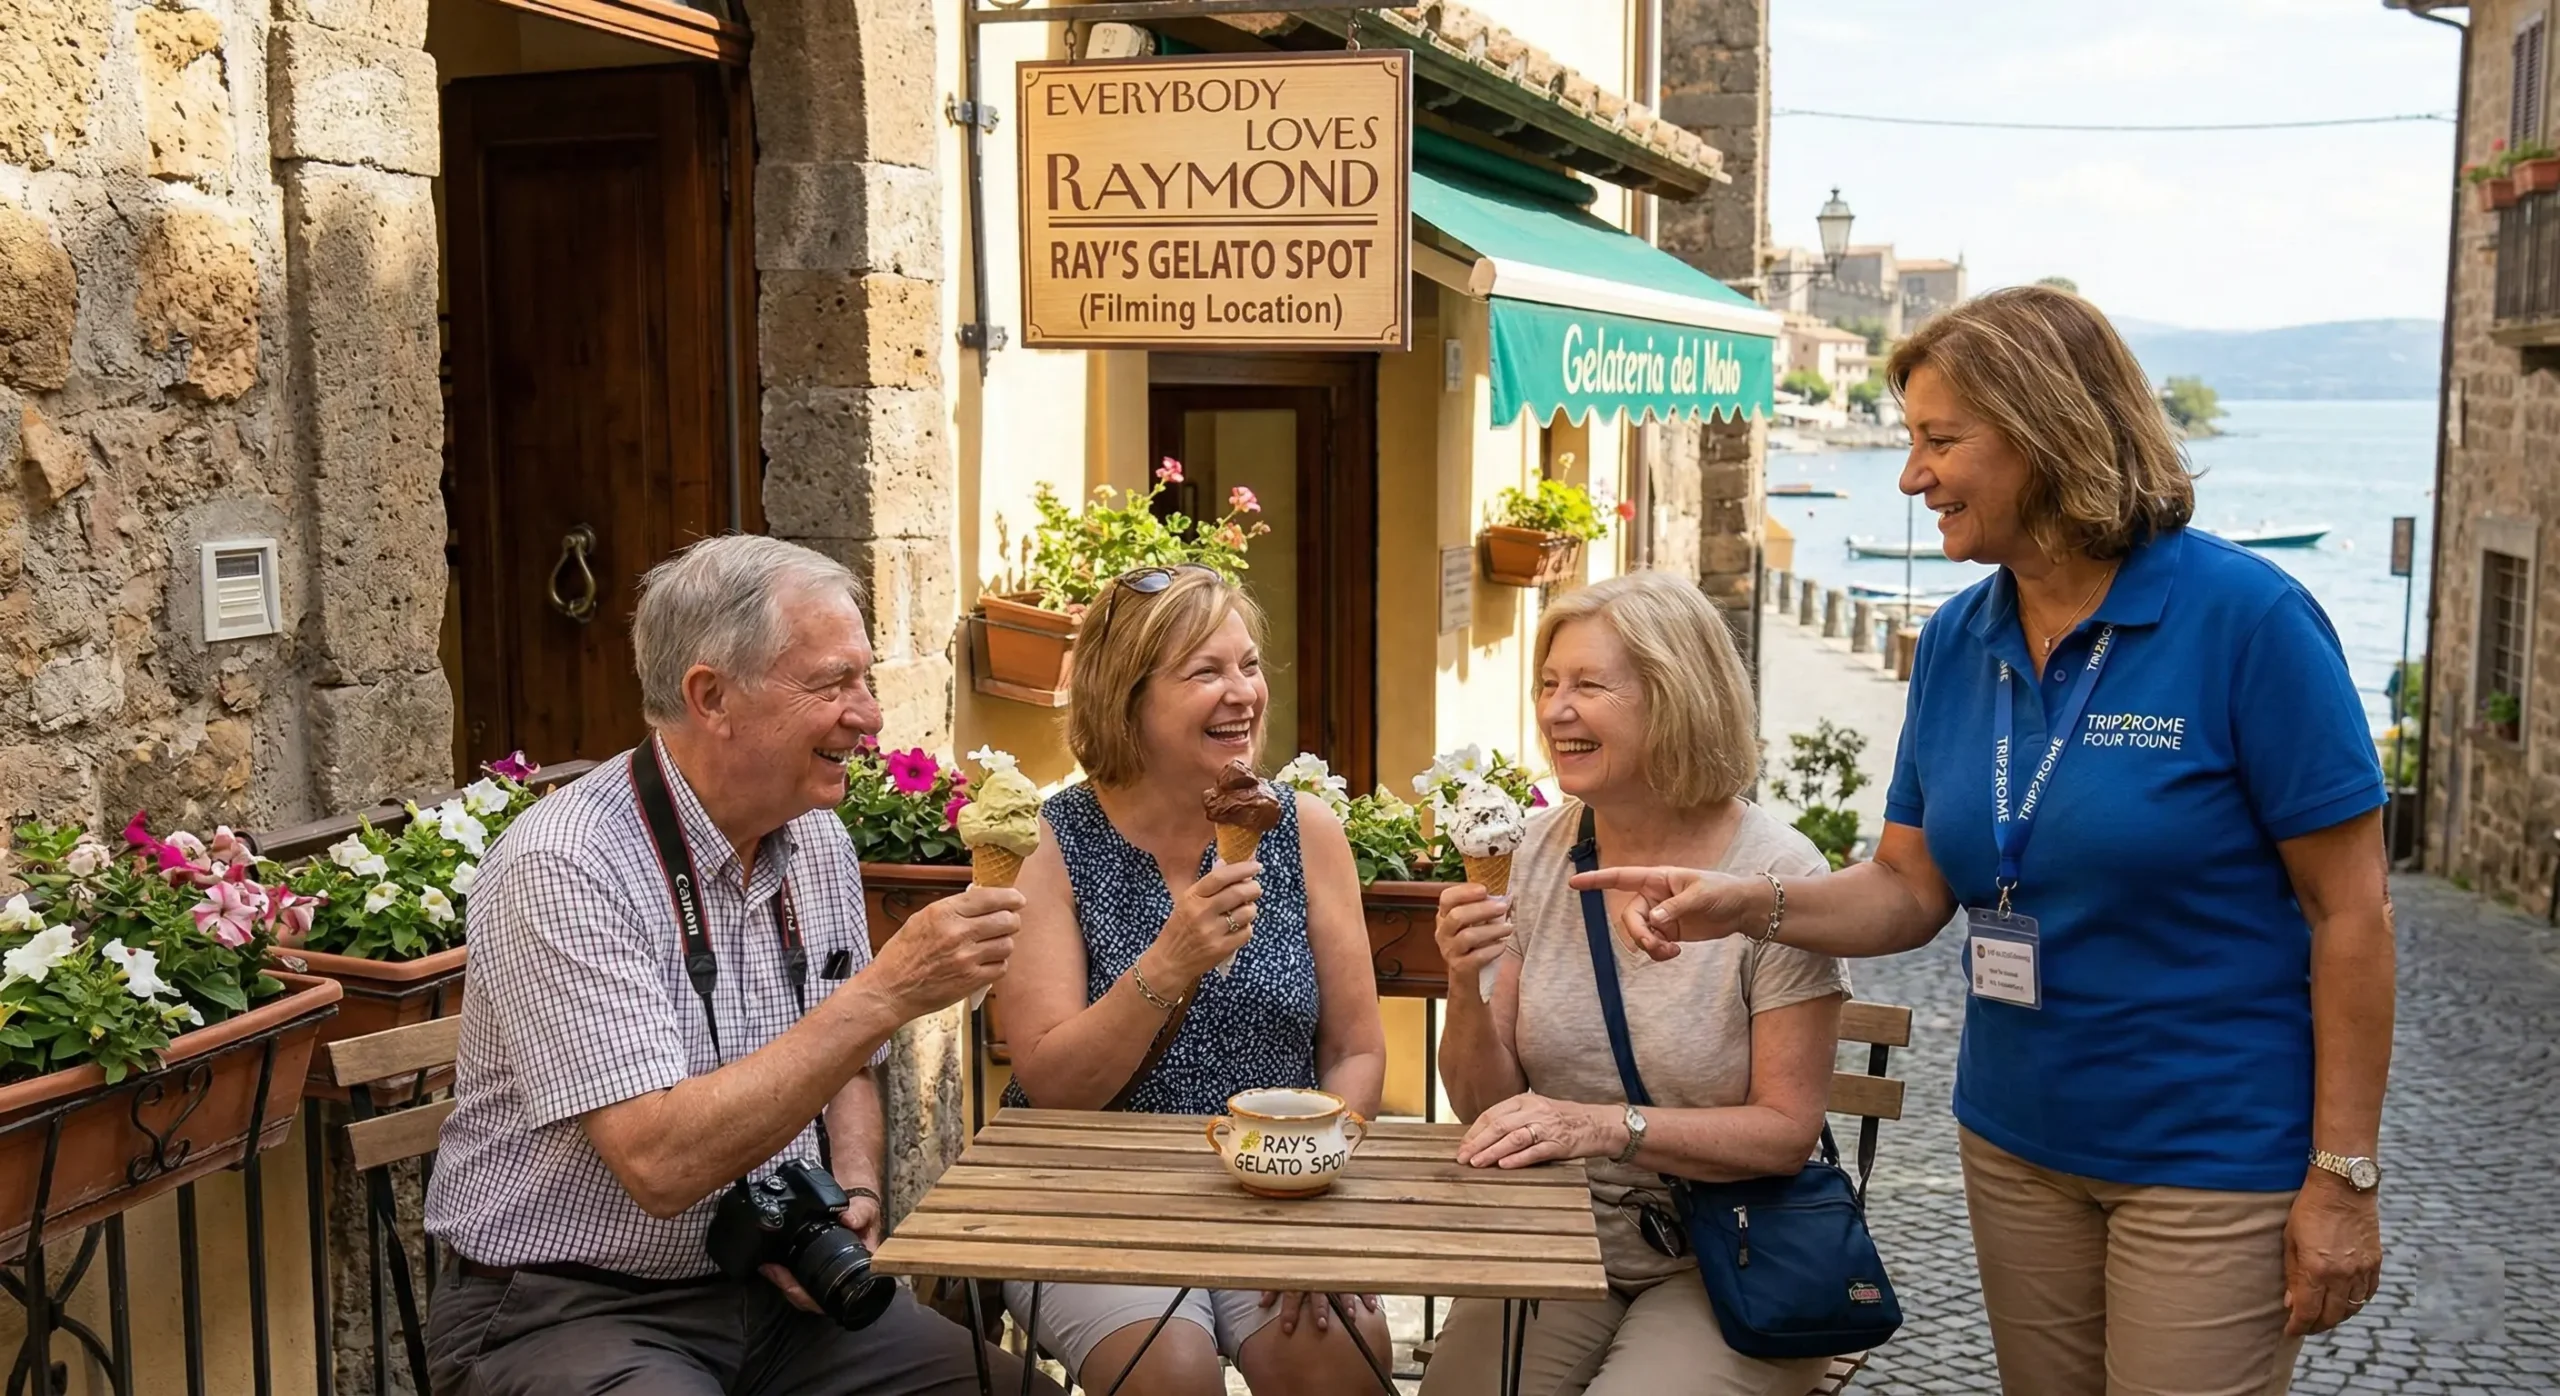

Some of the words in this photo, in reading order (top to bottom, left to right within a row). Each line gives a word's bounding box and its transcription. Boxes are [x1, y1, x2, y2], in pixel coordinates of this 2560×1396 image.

[1046, 78, 1286, 116] EVERYBODY
[1246, 116, 1379, 151] LOVES
[1047, 153, 1379, 211] RAYMOND
[1050, 240, 1139, 279] RAY'S
[1150, 240, 1276, 279] GELATO
[1285, 239, 1373, 279] SPOT
[1079, 293, 1196, 330] (Filming
[1206, 293, 1343, 331] Location)
[1562, 323, 1665, 395] Gelateria
[1670, 336, 1698, 395] del
[1702, 339, 1741, 395] Molo
[2082, 732, 2124, 747] FOUR
[2128, 733, 2182, 750] TOUNE
[2087, 713, 2185, 734] TRIP2ROME
[675, 873, 699, 936] Canon
[1234, 1153, 1302, 1175] GELATO
[1310, 1150, 1346, 1174] SPOT
[1263, 1134, 1317, 1154] RAY'S
